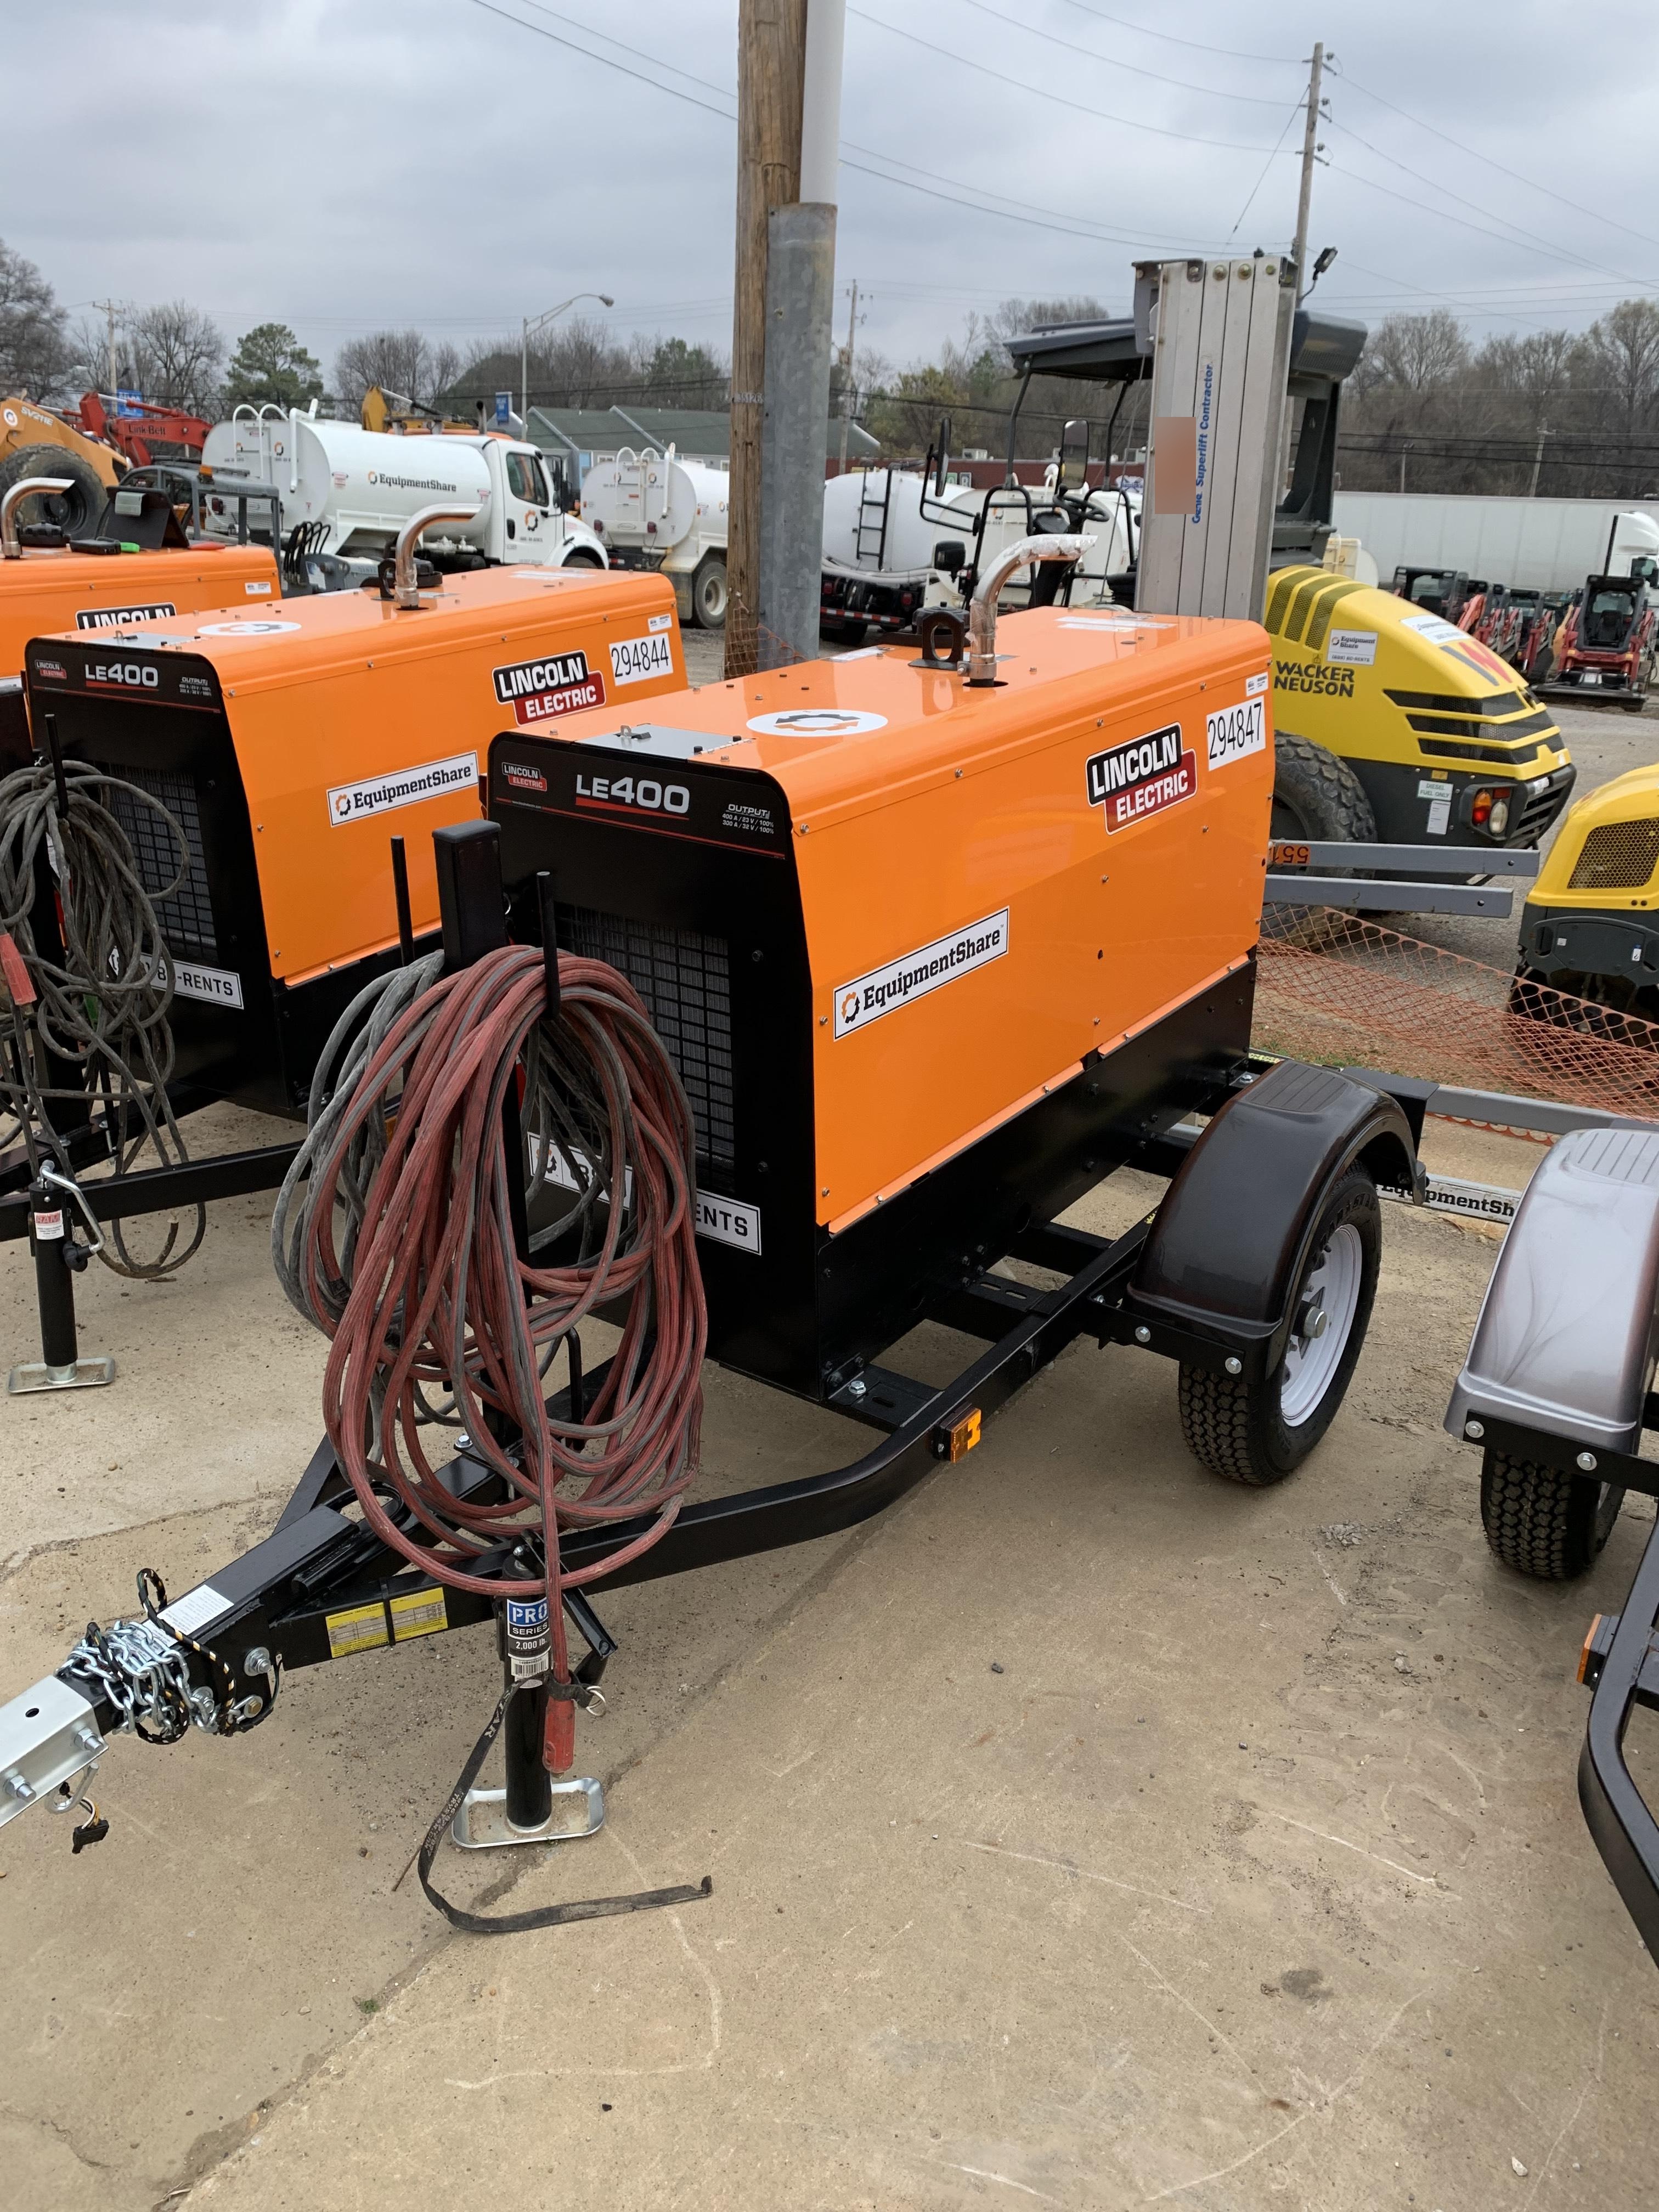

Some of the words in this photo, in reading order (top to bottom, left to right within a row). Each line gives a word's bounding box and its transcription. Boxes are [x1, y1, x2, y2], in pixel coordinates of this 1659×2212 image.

[1200, 364, 1213, 430] Contractor
[128, 424, 166, 435] Link-Belt
[1195, 433, 1207, 487] Superlift
[379, 473, 456, 492] EquipmentShare
[1340, 636, 1375, 645] Equipment
[36, 661, 60, 670] LINCOLN
[611, 637, 669, 678] 294844
[85, 663, 159, 687] LE400
[498, 657, 584, 698] LINCOLN
[1276, 660, 1355, 682] WACKER
[1274, 675, 1355, 697] NEUSON
[525, 685, 597, 719] ELECTRIC
[1208, 702, 1262, 760] 294847
[504, 764, 538, 779] LINCOLN
[1092, 732, 1178, 797] LINCOLN
[353, 765, 471, 809] EquipmentShare
[513, 777, 543, 788] ELECTRIC
[576, 774, 690, 814] LE400
[1116, 769, 1188, 822] ELECTRIC
[728, 804, 768, 816] OUTPUT
[759, 820, 774, 828] 100%
[864, 928, 1000, 1011] EquipmentShare
[157, 967, 233, 996] 8-RENTS
[512, 1603, 548, 1623] PRO
[512, 1622, 548, 1635] SERIES
[516, 1640, 537, 1650] 2,000
